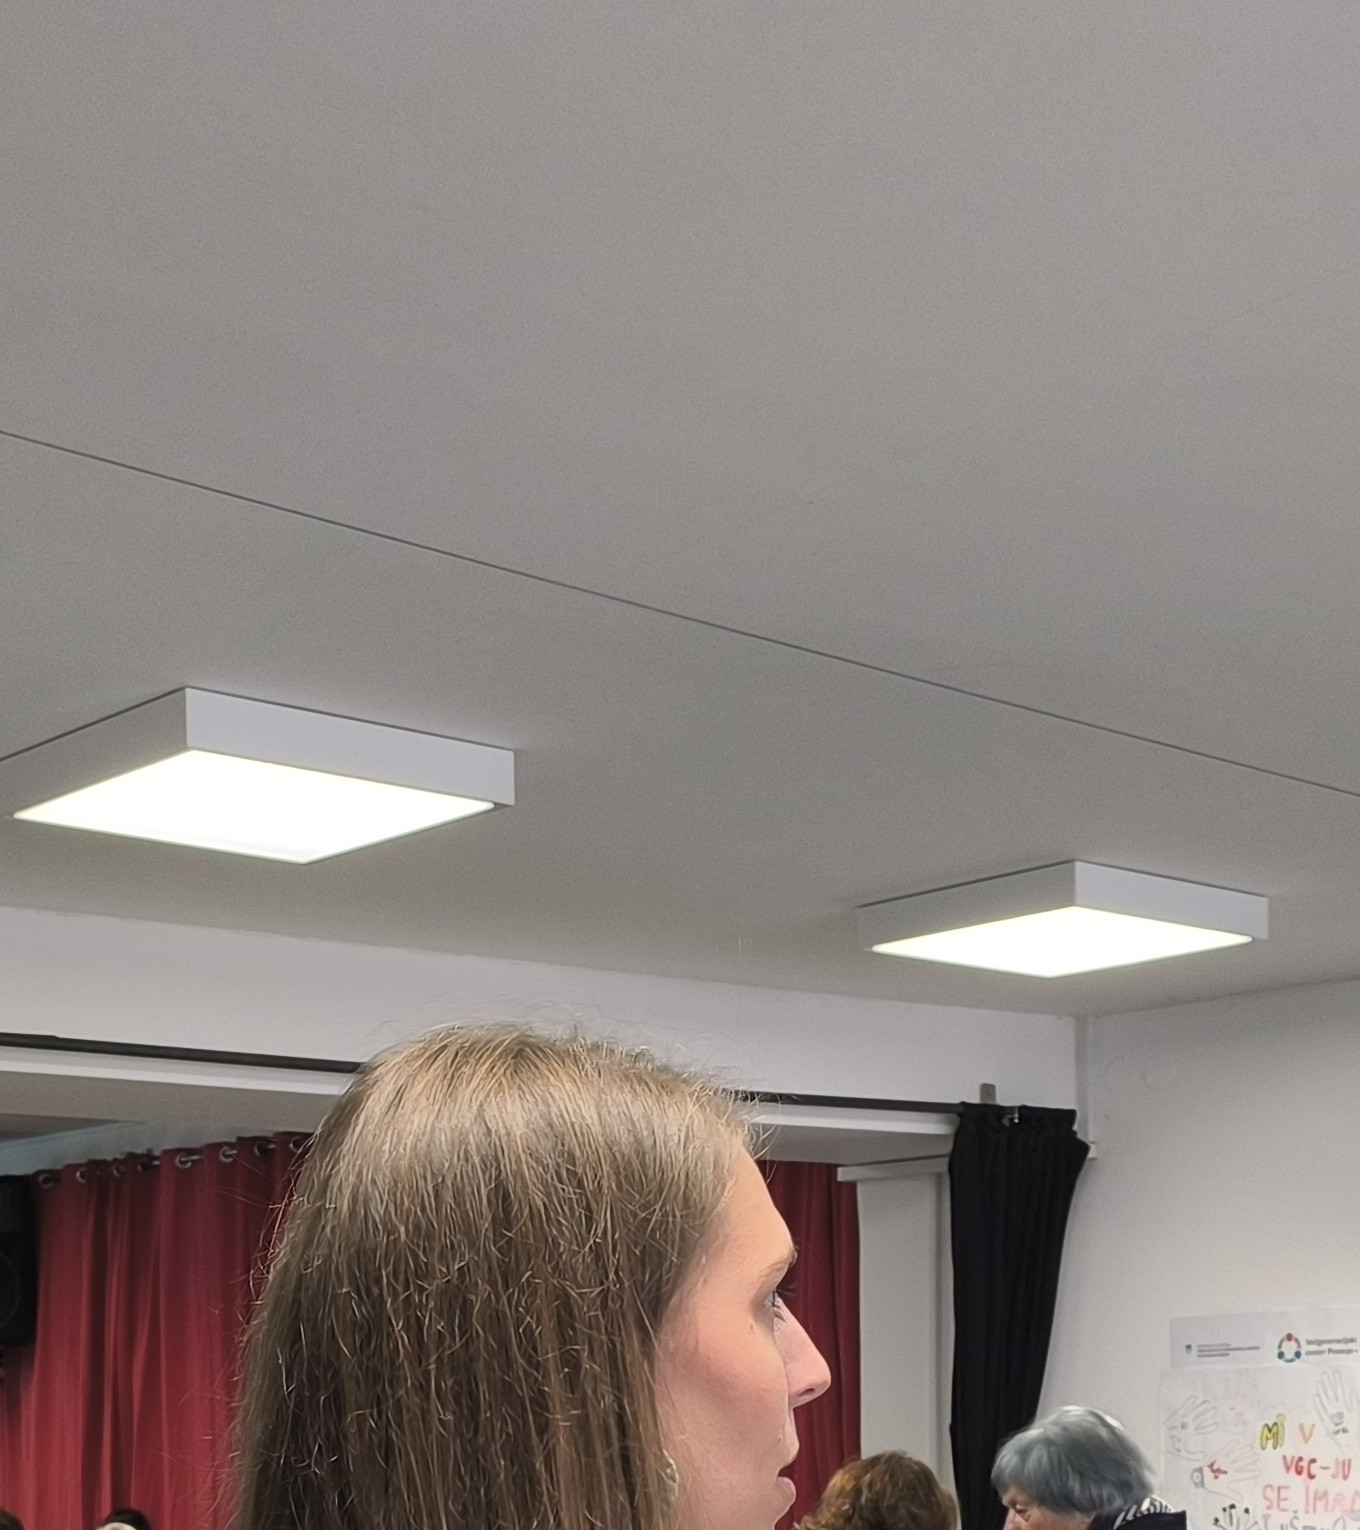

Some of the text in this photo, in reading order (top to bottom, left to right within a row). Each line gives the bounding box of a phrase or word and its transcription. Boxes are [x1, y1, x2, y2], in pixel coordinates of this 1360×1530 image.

[1298, 1422, 1316, 1444] V
[1282, 1454, 1352, 1481] VGC-JU
[1262, 1483, 1291, 1512] SE
